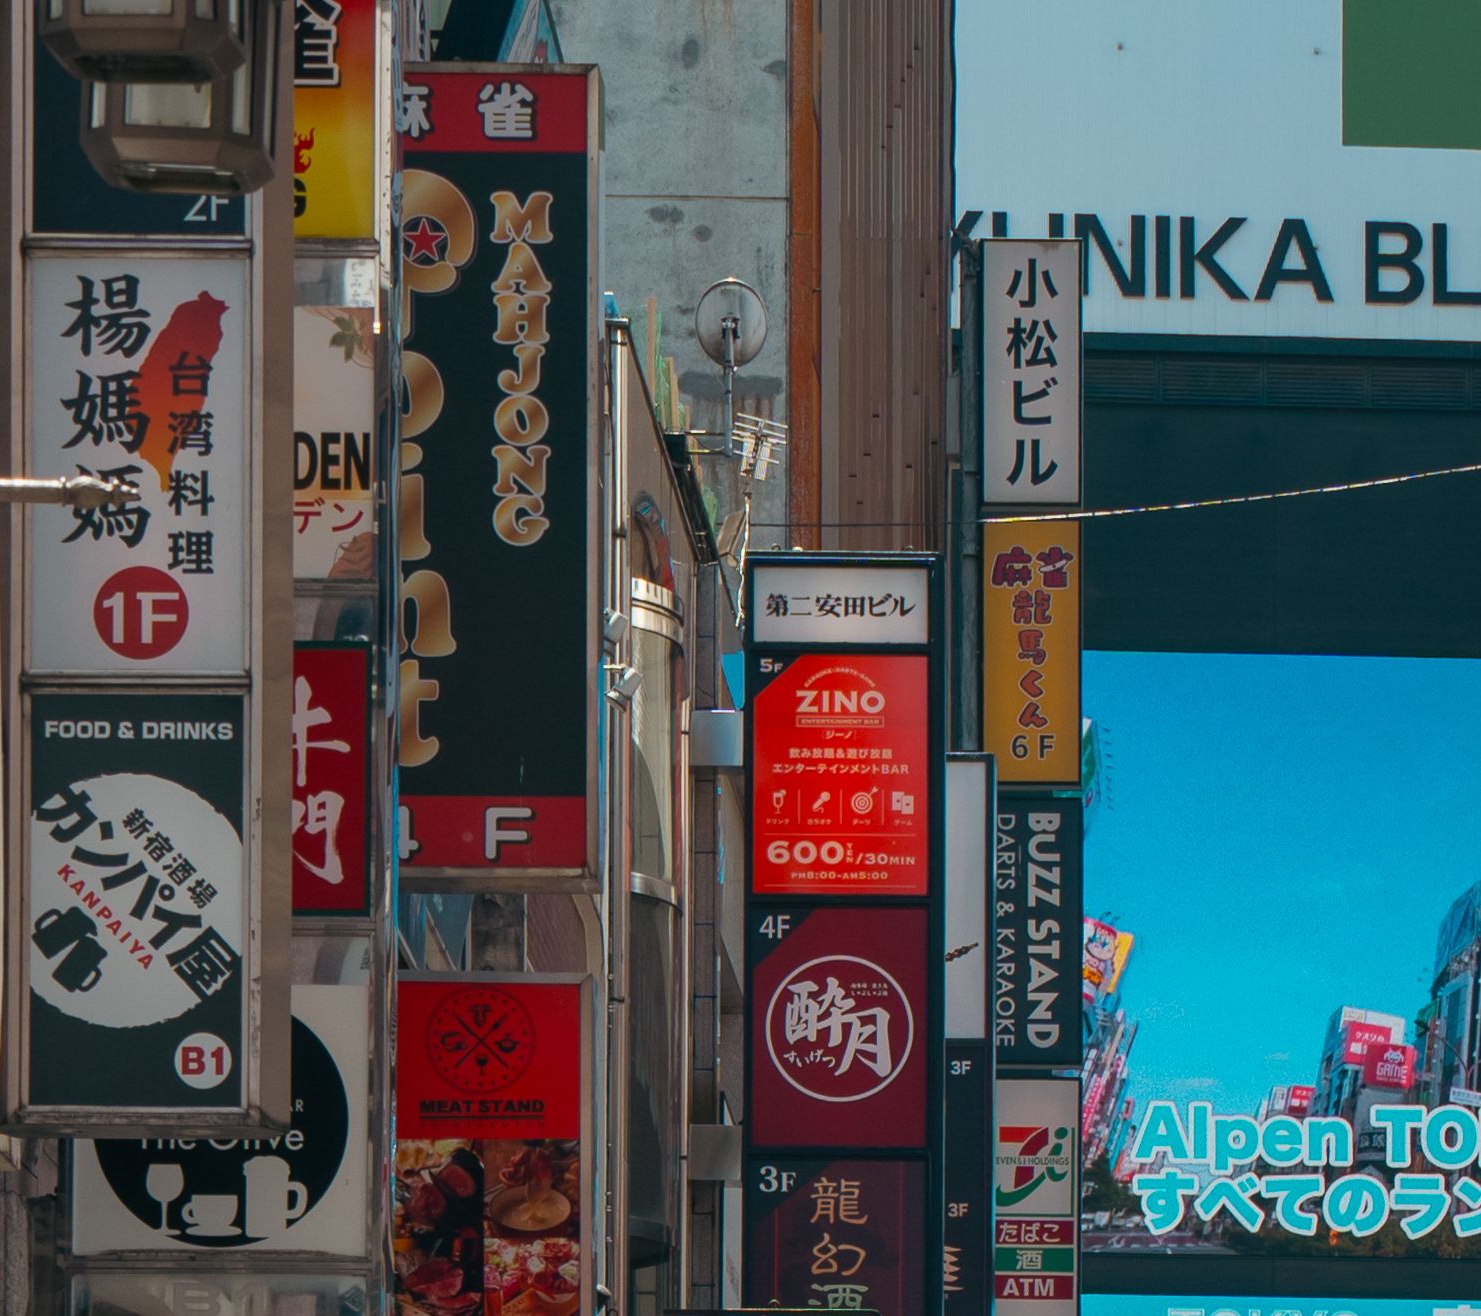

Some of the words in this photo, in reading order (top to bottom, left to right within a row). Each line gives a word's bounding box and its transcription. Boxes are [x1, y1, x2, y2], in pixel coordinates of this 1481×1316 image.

[490, 191, 553, 546] MAHJONG
[1005, 257, 1059, 488] 小松ビル
[167, 351, 215, 575] 台湾料理
[102, 591, 180, 644] 1F
[766, 594, 916, 617] 第二安田ビル
[760, 658, 782, 673] 5F
[796, 690, 885, 713] ZINO
[44, 720, 110, 740] FOOD
[117, 721, 135, 739] &
[142, 720, 233, 741] DRINKS
[773, 764, 909, 775] エンターテインメントBAR
[122, 806, 218, 909] 新宿酒場
[767, 841, 844, 864] 600
[996, 814, 1016, 890] DARTS
[1027, 813, 1061, 907] BUZZ
[31, 786, 241, 1002] カンパイ屋
[56, 863, 154, 971] KANPAIYA
[759, 916, 790, 939] 4F
[996, 929, 1016, 1048] KARAOKE
[1027, 920, 1061, 1048] STAND
[785, 977, 891, 1078] 酔月
[179, 1046, 227, 1075] B1
[950, 1060, 971, 1076] 3F
[420, 1099, 471, 1113] MEAT
[479, 1099, 544, 1113] STAND
[1134, 1102, 1353, 1168] Alpen
[759, 1166, 796, 1193] 3F
[948, 1204, 968, 1218] 3F
[999, 1223, 1061, 1243] たばこ
[1016, 1250, 1043, 1271] 酒
[1002, 1278, 1056, 1298] ATM
